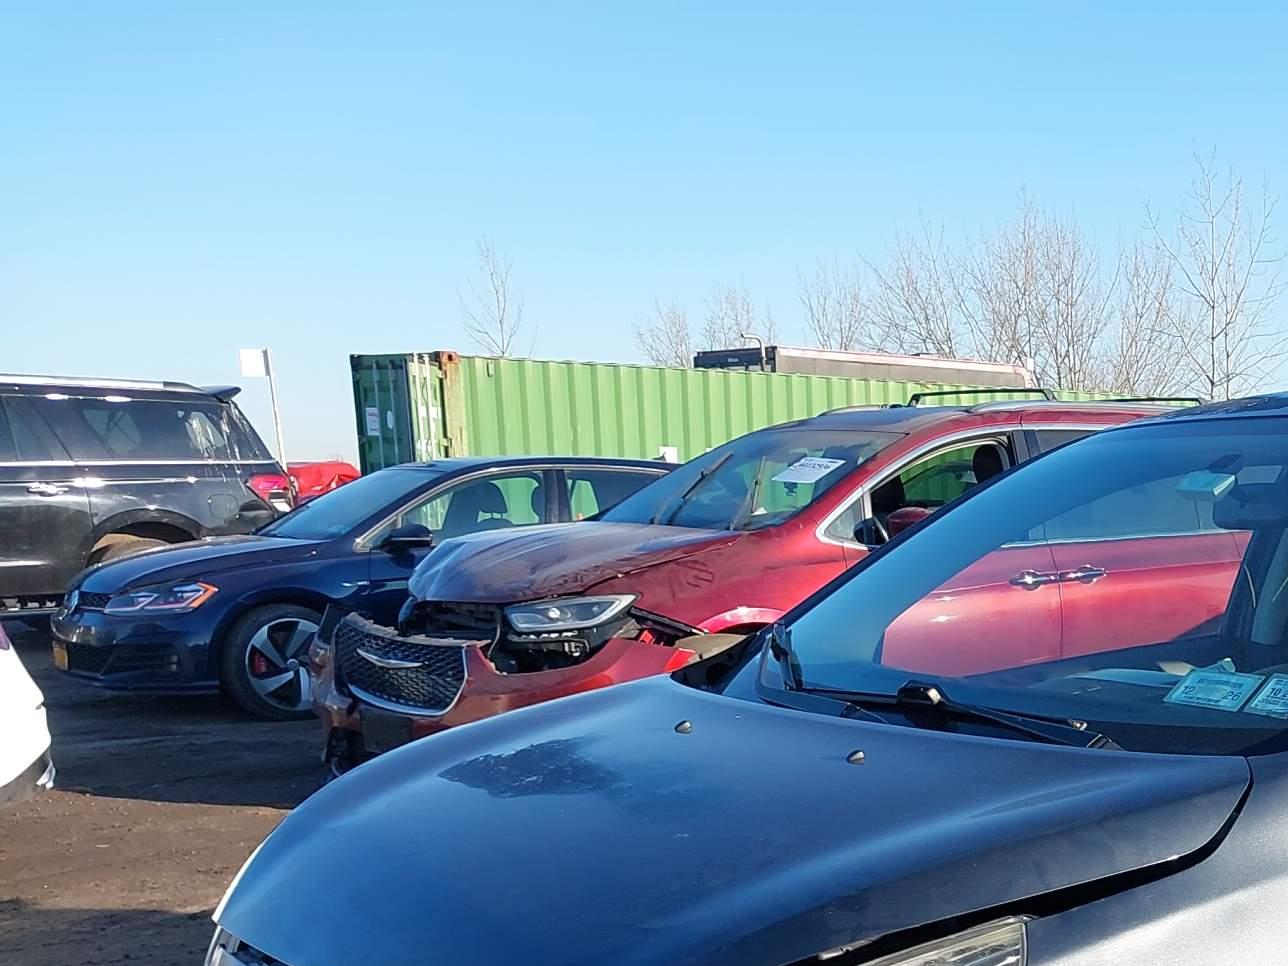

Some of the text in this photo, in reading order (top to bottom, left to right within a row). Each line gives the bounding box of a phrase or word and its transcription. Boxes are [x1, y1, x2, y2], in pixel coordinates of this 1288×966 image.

[1181, 684, 1197, 696] 12
[1221, 690, 1243, 702] 26
[1269, 687, 1282, 697] 10
